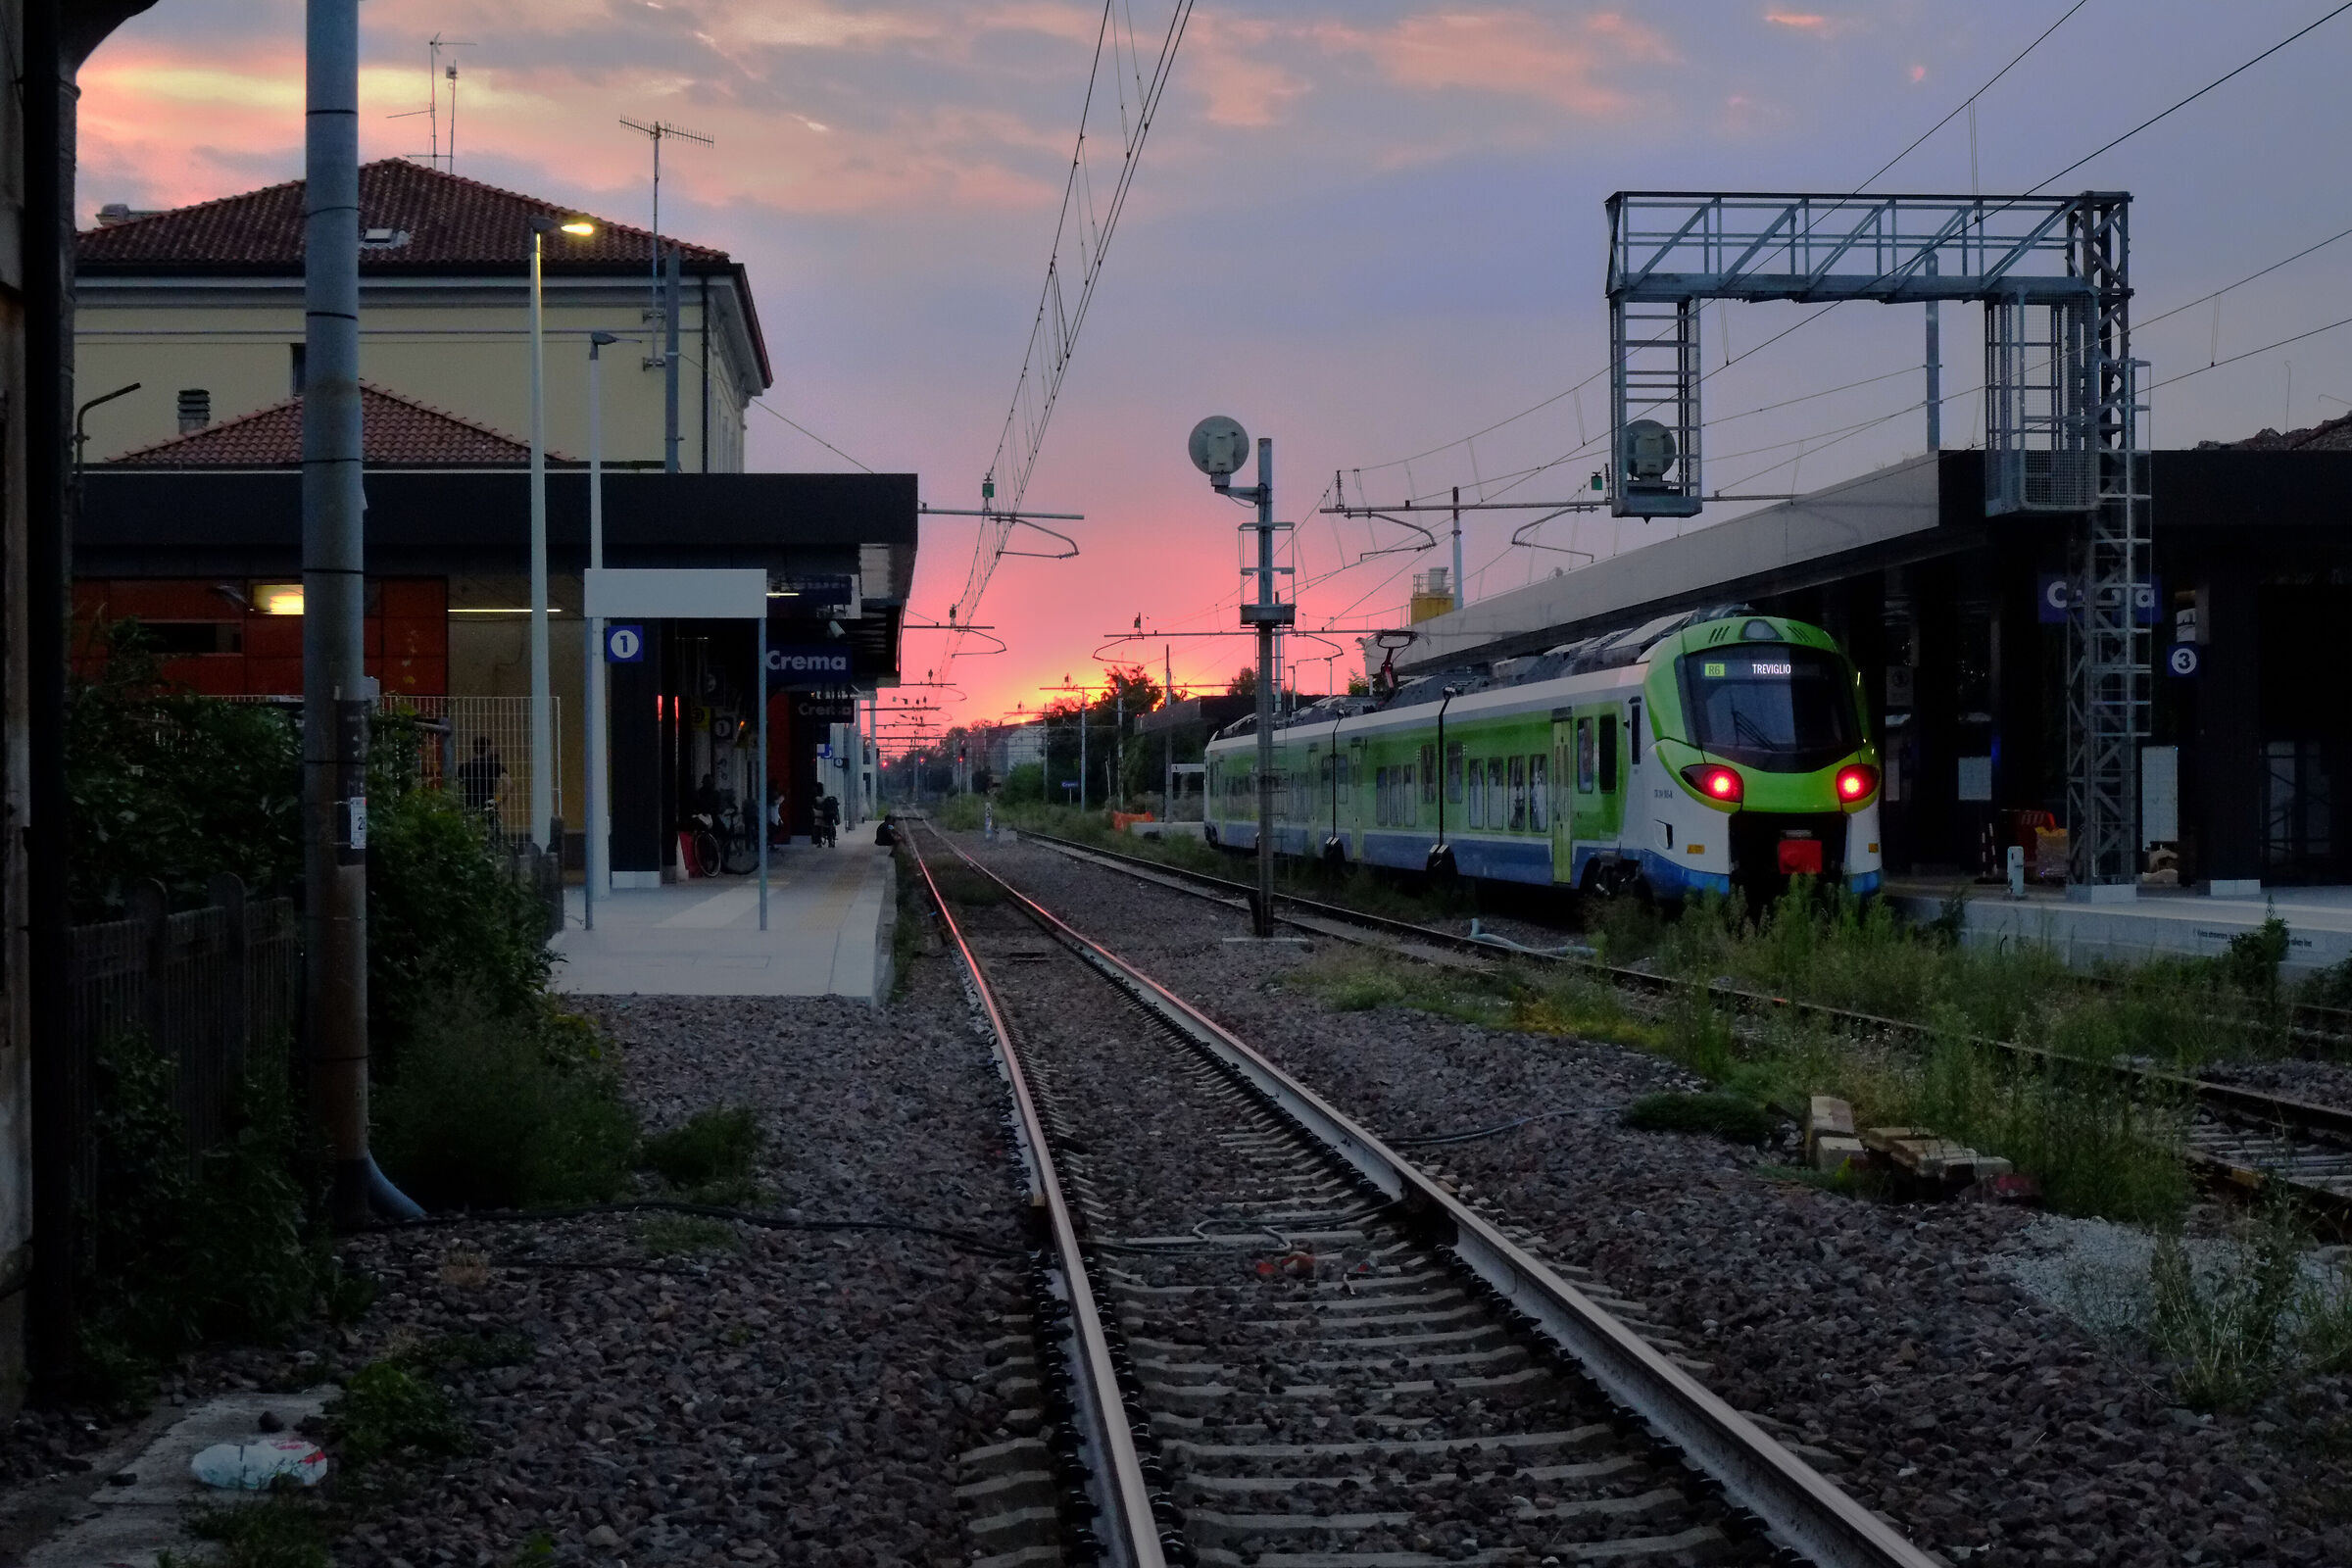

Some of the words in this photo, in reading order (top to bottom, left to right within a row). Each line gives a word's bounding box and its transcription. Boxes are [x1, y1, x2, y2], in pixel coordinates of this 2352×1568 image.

[620, 635, 628, 653] 1
[766, 650, 847, 670] Crema
[2178, 652, 2190, 669] 3
[1708, 664, 1721, 675] R6
[1752, 663, 1791, 674] TREVIGLIO
